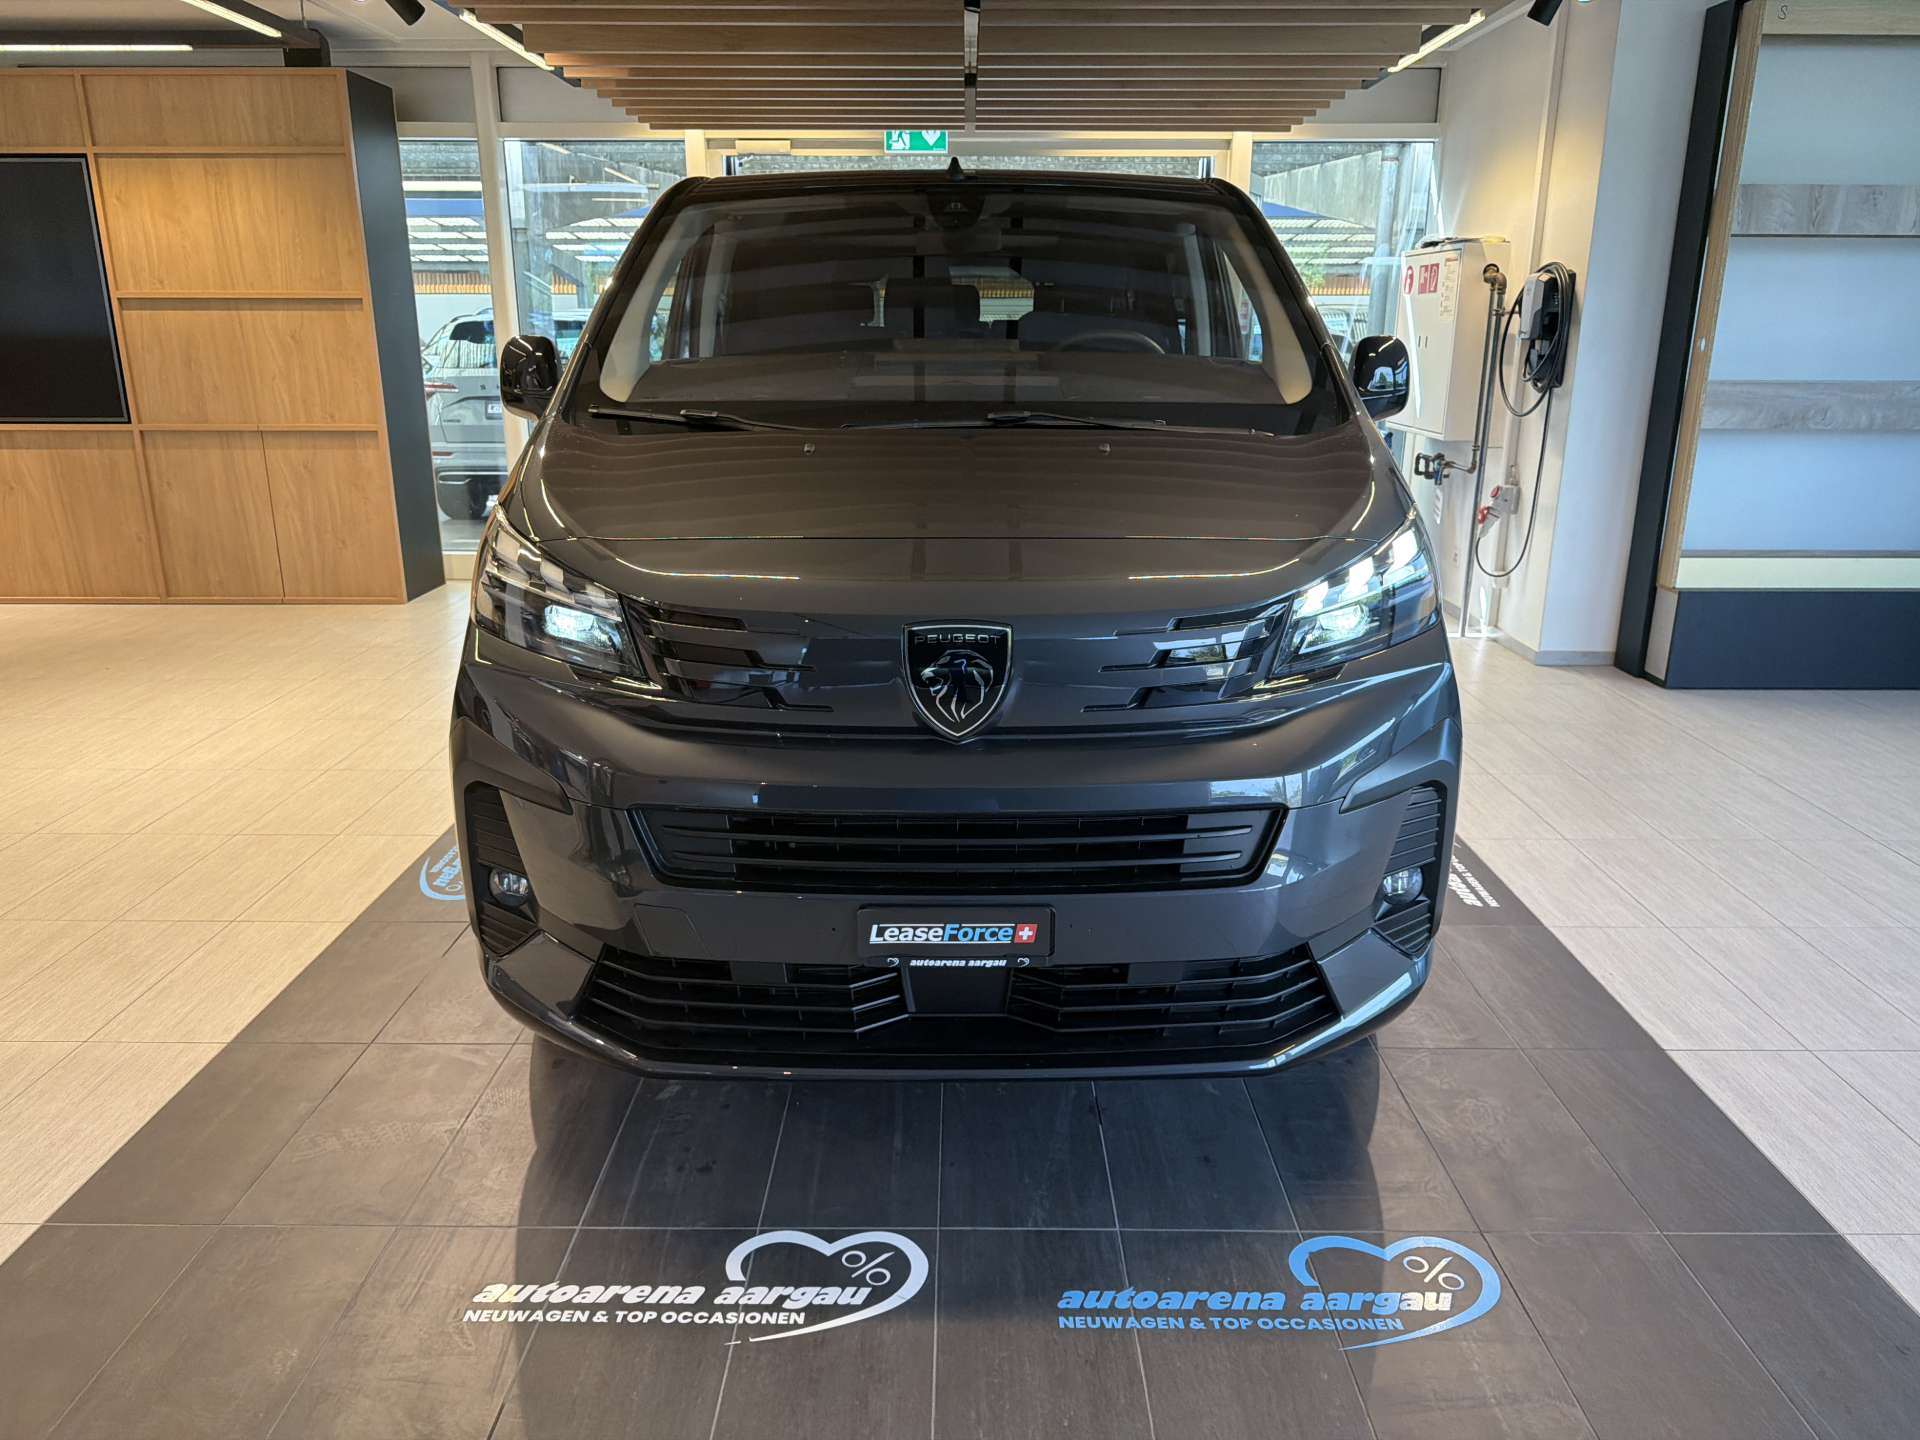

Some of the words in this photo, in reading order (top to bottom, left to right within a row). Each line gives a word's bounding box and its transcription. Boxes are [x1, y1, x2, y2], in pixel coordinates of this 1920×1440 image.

[914, 633, 1001, 645] PEUGEOT
[869, 923, 1014, 943] LeaseForce
[910, 958, 966, 967] autoarena
[967, 958, 1007, 968] aargau
[472, 1280, 707, 1305] autoarena
[714, 1285, 873, 1310] aargau
[1057, 1286, 1287, 1311] autoarena
[1300, 1291, 1453, 1315] aargau
[462, 1309, 590, 1323] NEUWAGEN
[592, 1310, 609, 1323] &
[615, 1310, 658, 1324] TOP
[660, 1311, 806, 1325] OCCASIONEN
[1058, 1316, 1185, 1329] NEUWAGEN
[1189, 1316, 1207, 1330] &
[1209, 1317, 1254, 1330] TOP
[1256, 1317, 1405, 1331] OCCASIONEN
